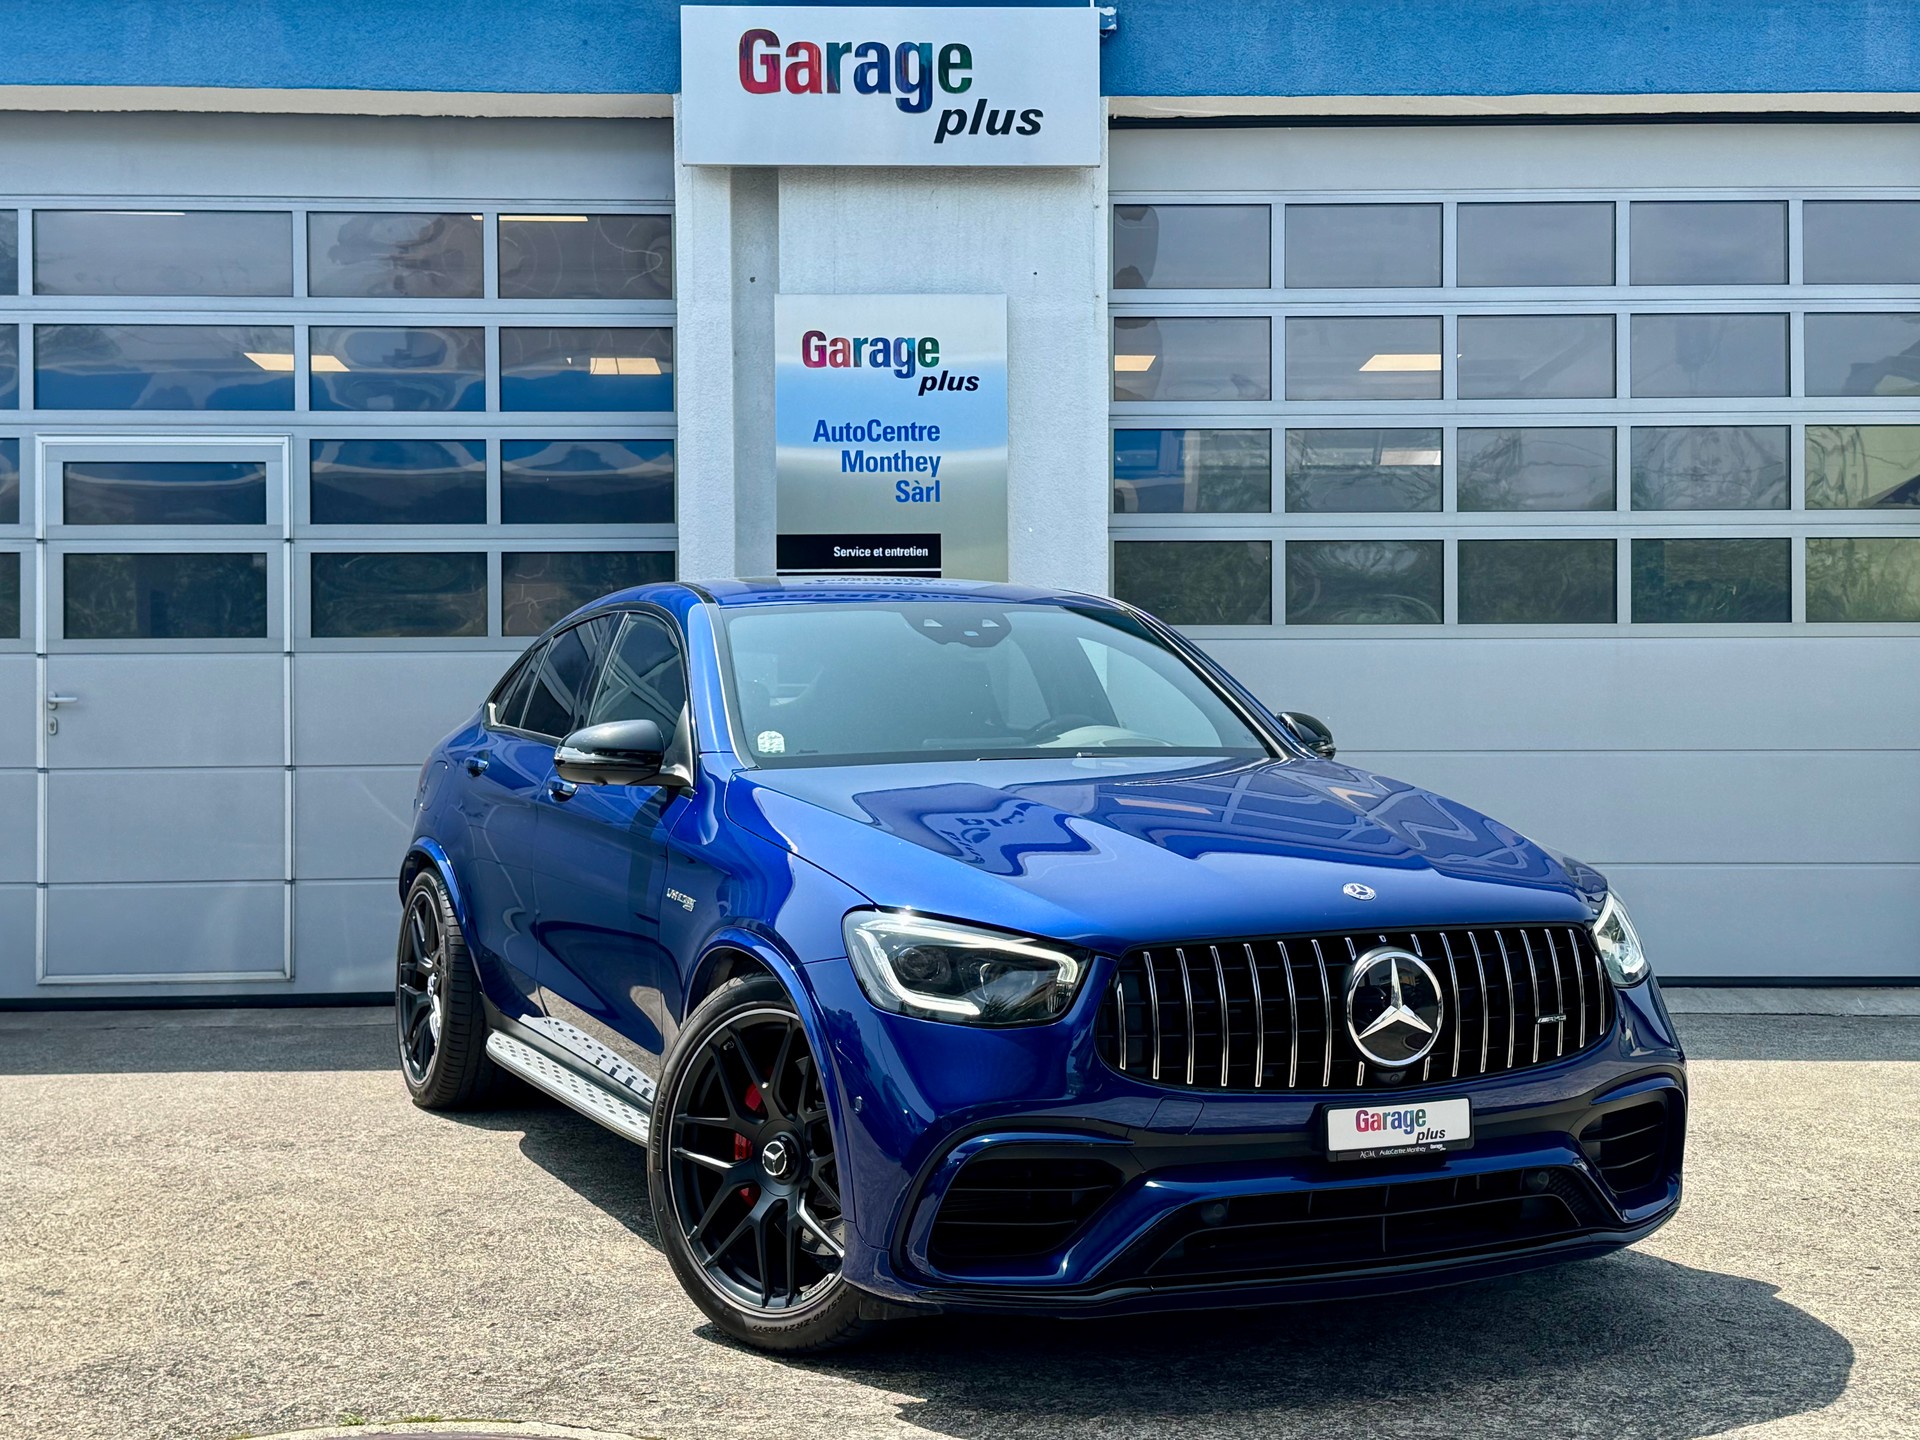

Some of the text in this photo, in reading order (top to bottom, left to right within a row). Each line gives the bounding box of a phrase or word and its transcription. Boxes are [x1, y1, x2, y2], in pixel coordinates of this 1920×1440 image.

[738, 28, 973, 114] Garage
[933, 98, 1044, 144] plus
[801, 330, 940, 379] Garage
[917, 370, 980, 396] plus
[812, 418, 941, 443] AutoCentre
[841, 449, 942, 478] Monthey
[895, 479, 941, 503] Sàrl
[833, 546, 929, 557] Service et entretien
[1355, 1109, 1427, 1134] Garage
[1416, 1128, 1446, 1144] plus
